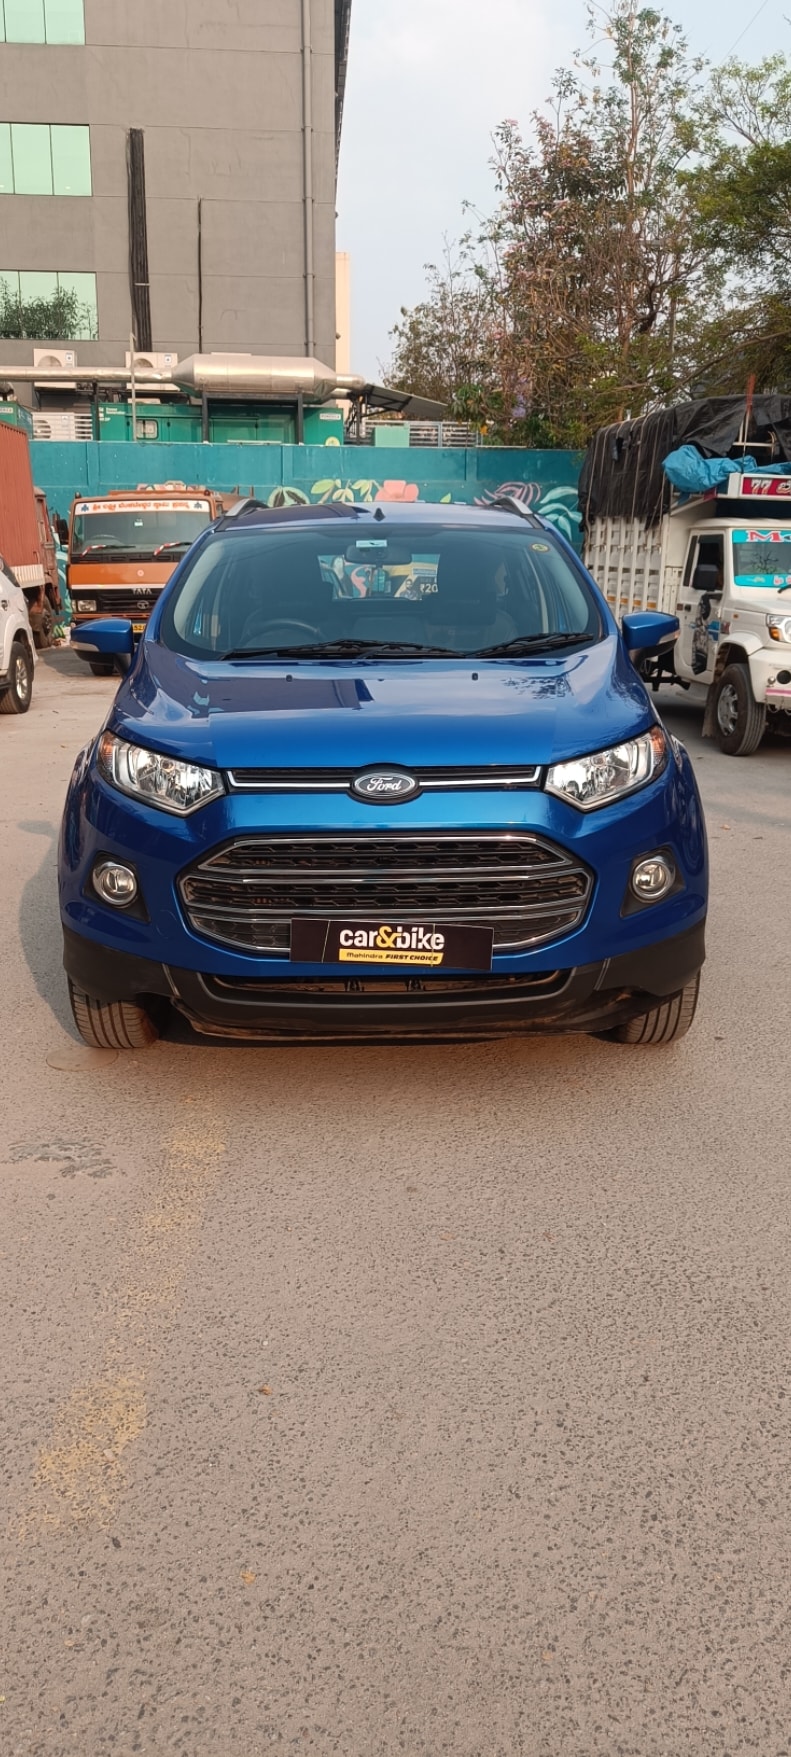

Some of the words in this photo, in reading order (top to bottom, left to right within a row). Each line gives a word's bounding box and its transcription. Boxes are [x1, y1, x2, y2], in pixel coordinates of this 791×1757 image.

[751, 478, 773, 495] 77
[366, 777, 402, 791] Ford
[339, 925, 445, 950] car&bike
